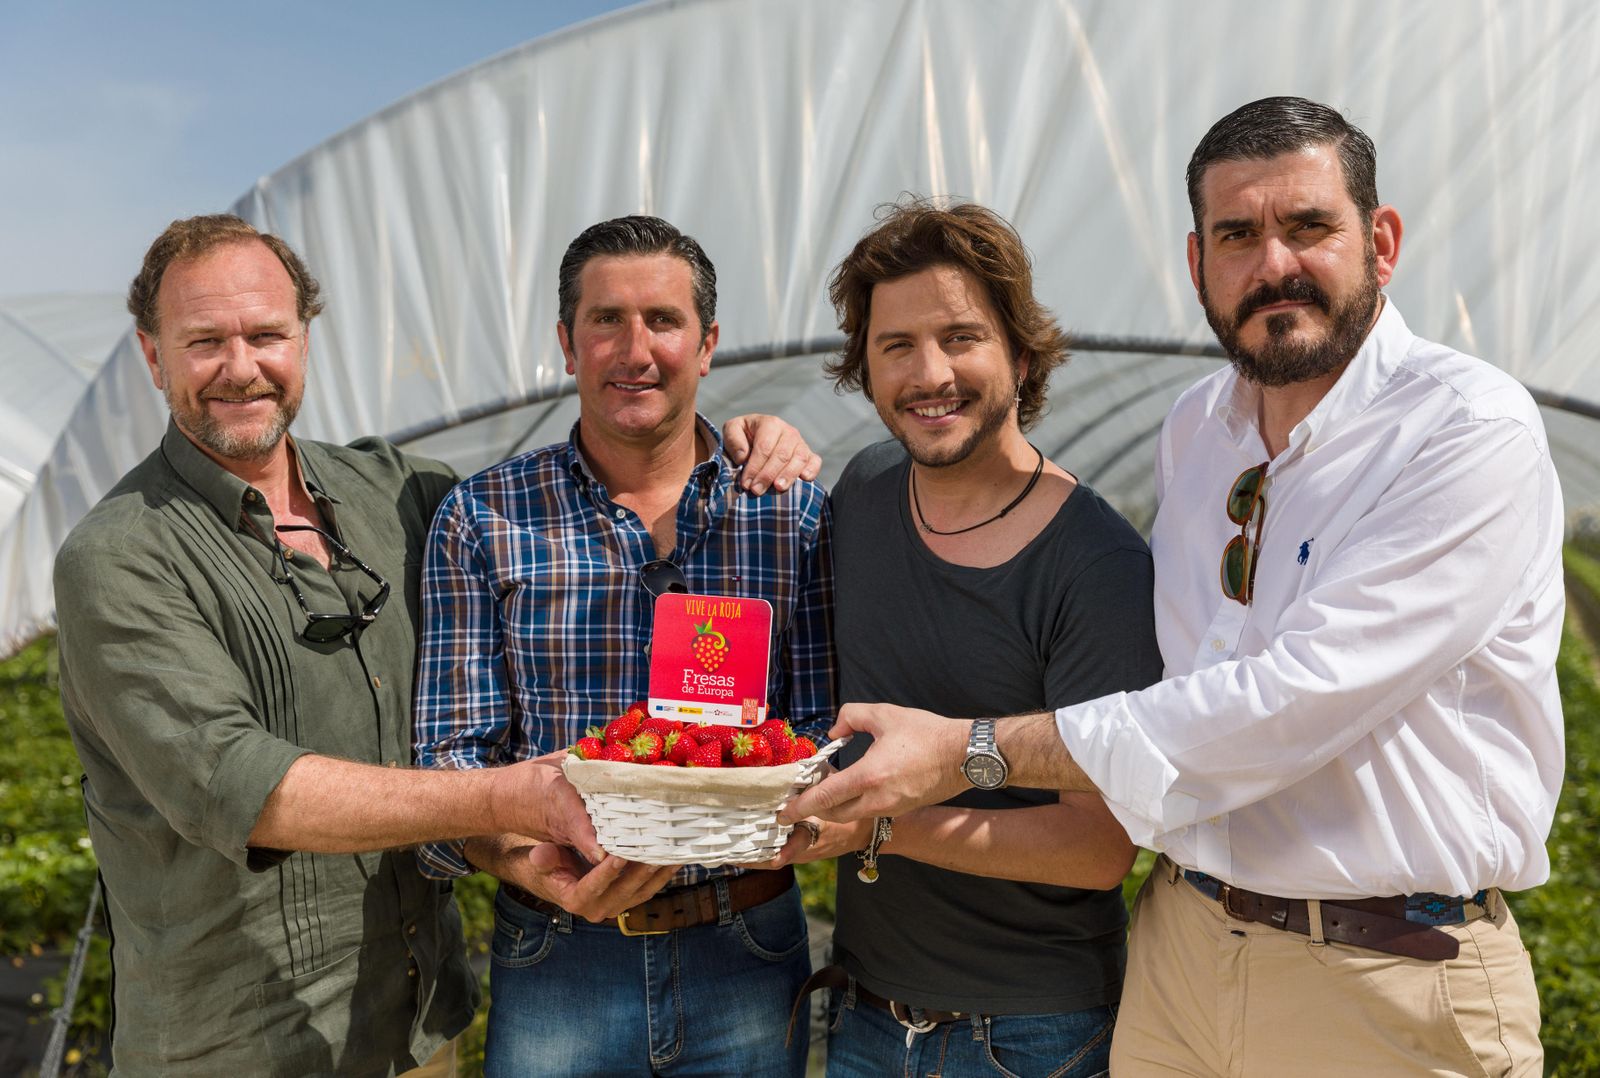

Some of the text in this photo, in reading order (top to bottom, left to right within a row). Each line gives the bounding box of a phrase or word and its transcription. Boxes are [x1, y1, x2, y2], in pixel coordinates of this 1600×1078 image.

[685, 599, 741, 620] VIVE LA ROJA
[682, 668, 735, 687] Fresas
[681, 682, 734, 699] de Europa
